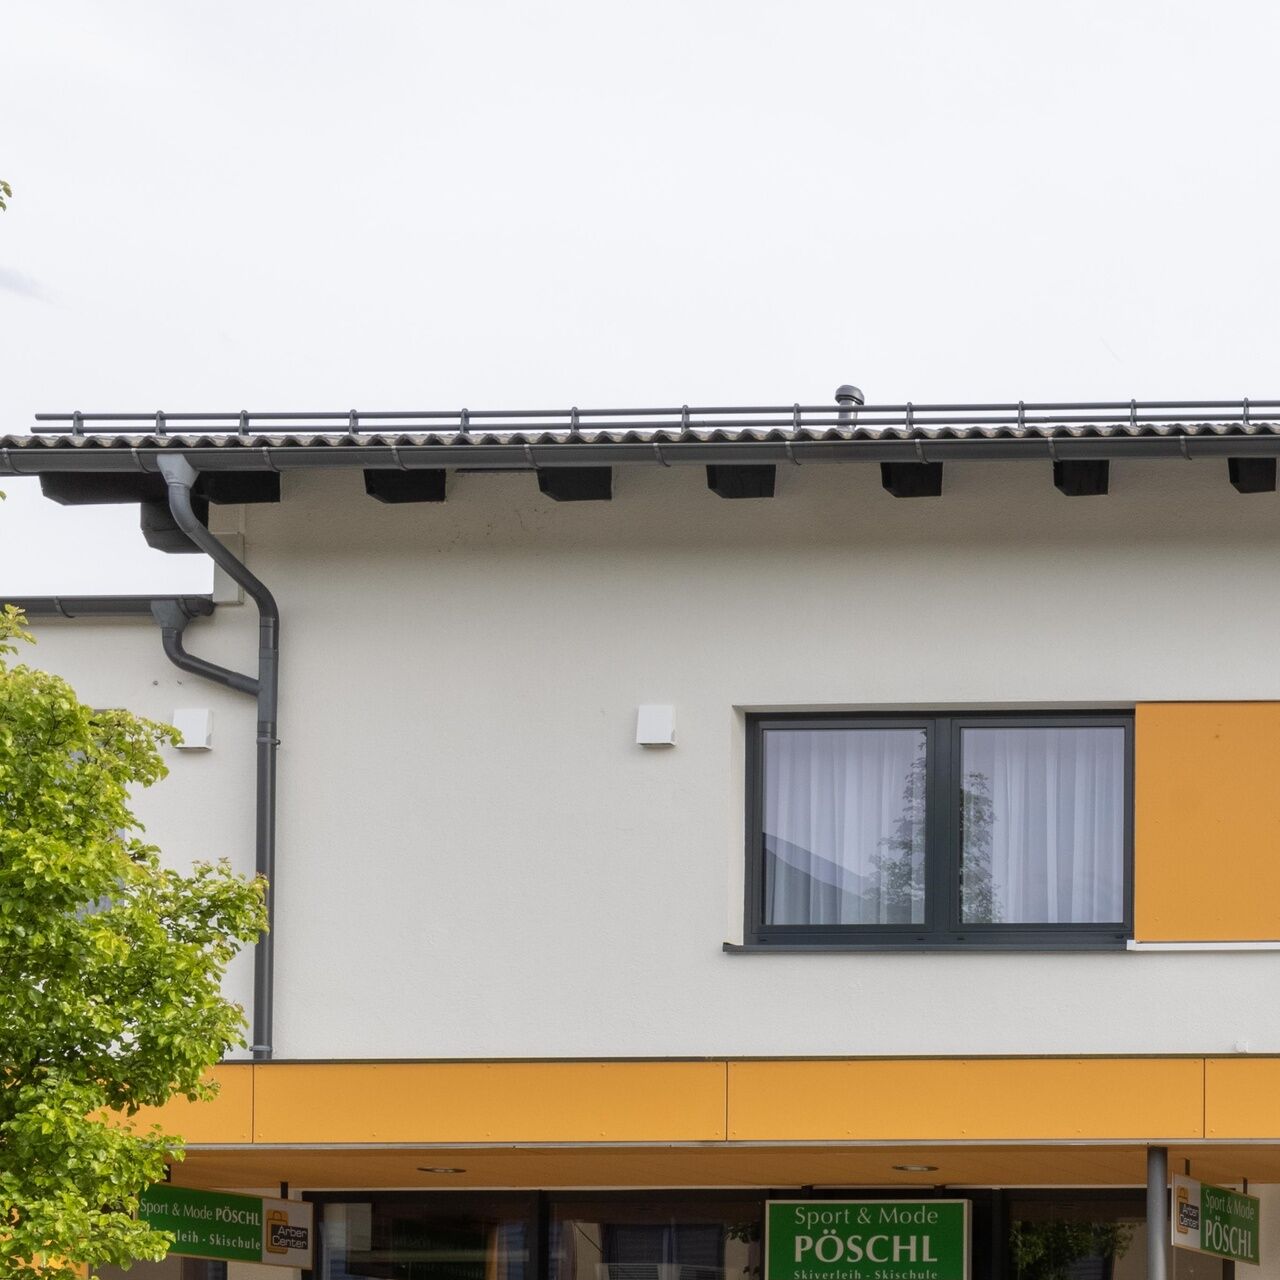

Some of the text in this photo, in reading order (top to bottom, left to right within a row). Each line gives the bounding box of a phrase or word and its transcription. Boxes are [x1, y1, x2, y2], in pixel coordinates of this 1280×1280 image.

[140, 1198, 261, 1226] Sport & Mode PÖSCHL
[1205, 1189, 1225, 1213] Sport
[1233, 1199, 1255, 1220] Mode
[794, 1205, 938, 1230] Sport & Mode
[209, 1232, 261, 1250] Skischule
[271, 1235, 308, 1249] Center
[277, 1225, 308, 1238] Arber
[1205, 1215, 1254, 1258] PÖSCHL
[794, 1228, 938, 1263] PÖSCHL
[794, 1269, 861, 1280] Skiverleih
[874, 1269, 938, 1280] Skischule
